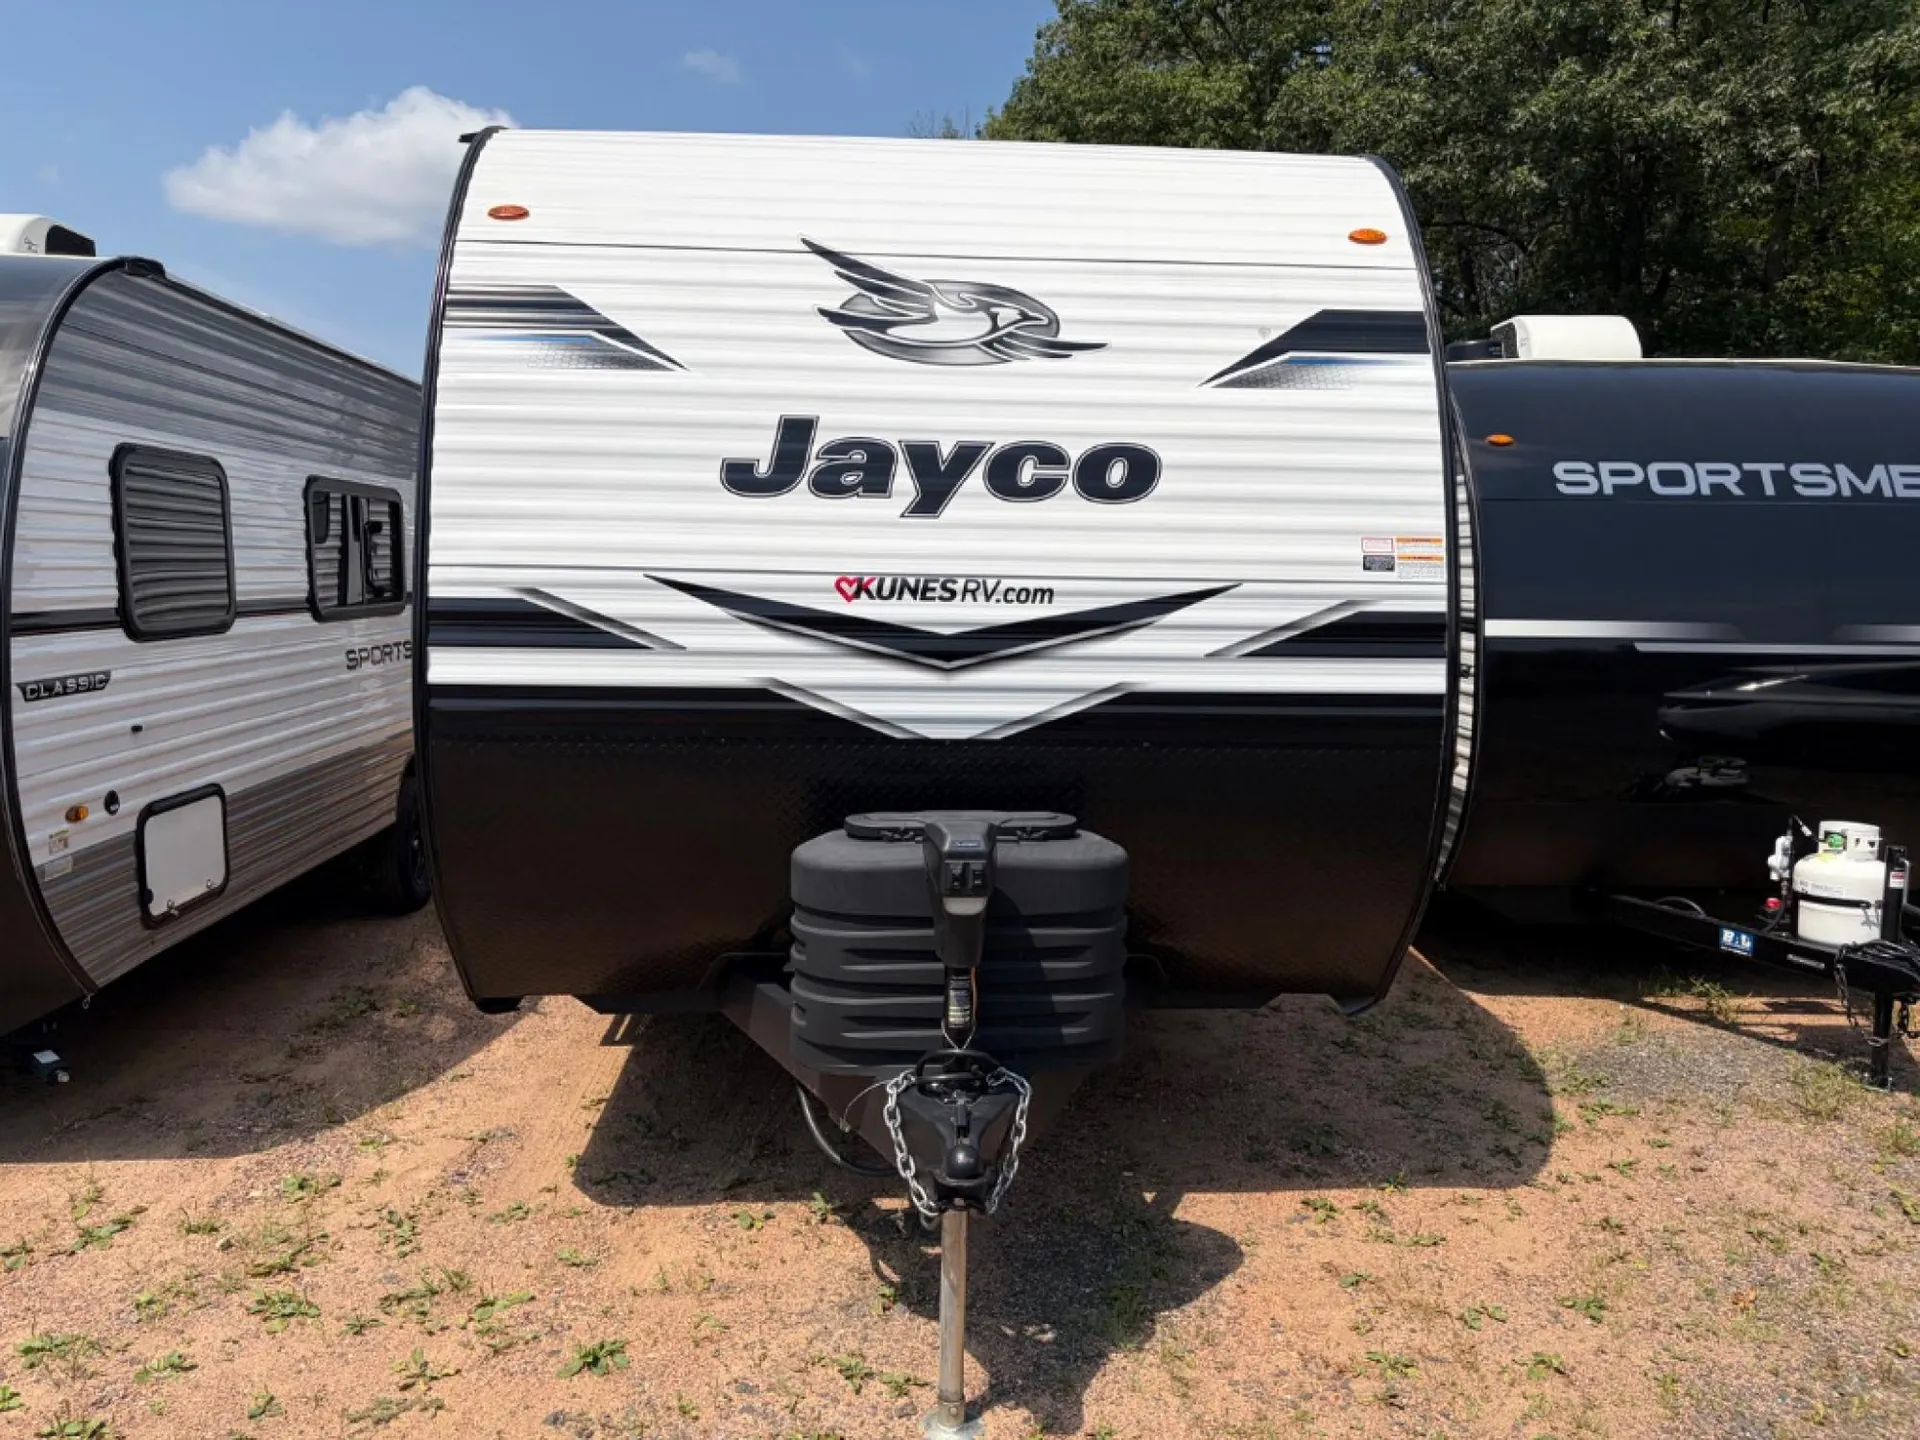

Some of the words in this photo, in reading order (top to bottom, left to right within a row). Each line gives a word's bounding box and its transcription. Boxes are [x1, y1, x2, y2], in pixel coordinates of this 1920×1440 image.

[720, 414, 1162, 518] Jayco
[1552, 461, 1920, 498] SPORTSME
[345, 640, 413, 670] SPORTS
[26, 674, 106, 699] CLASSIC
